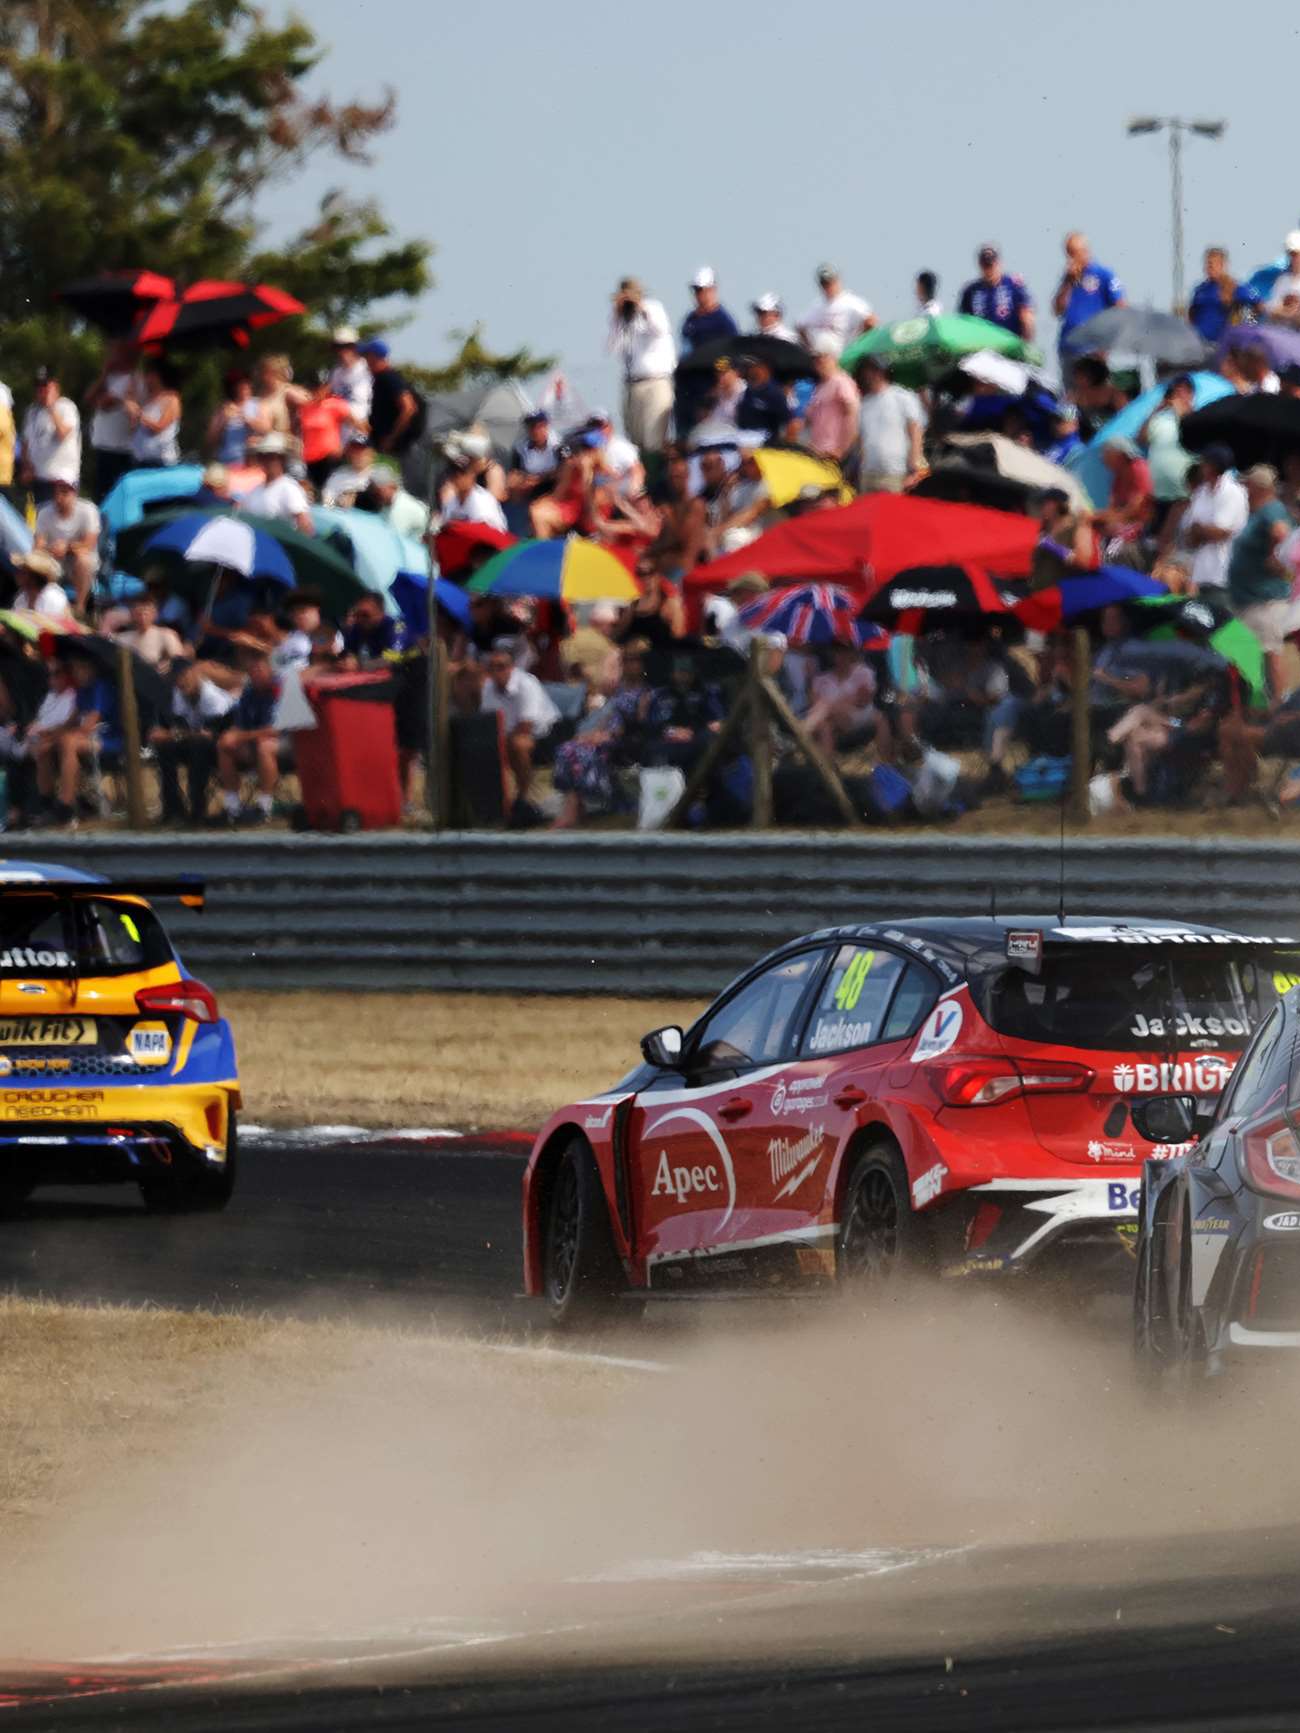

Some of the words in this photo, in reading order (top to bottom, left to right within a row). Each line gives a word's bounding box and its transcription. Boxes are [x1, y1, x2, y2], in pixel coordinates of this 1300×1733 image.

[834, 950, 875, 1011] 48
[135, 1032, 165, 1050] NAPA
[809, 1017, 872, 1050] Jackson
[651, 1149, 718, 1203] Apec
